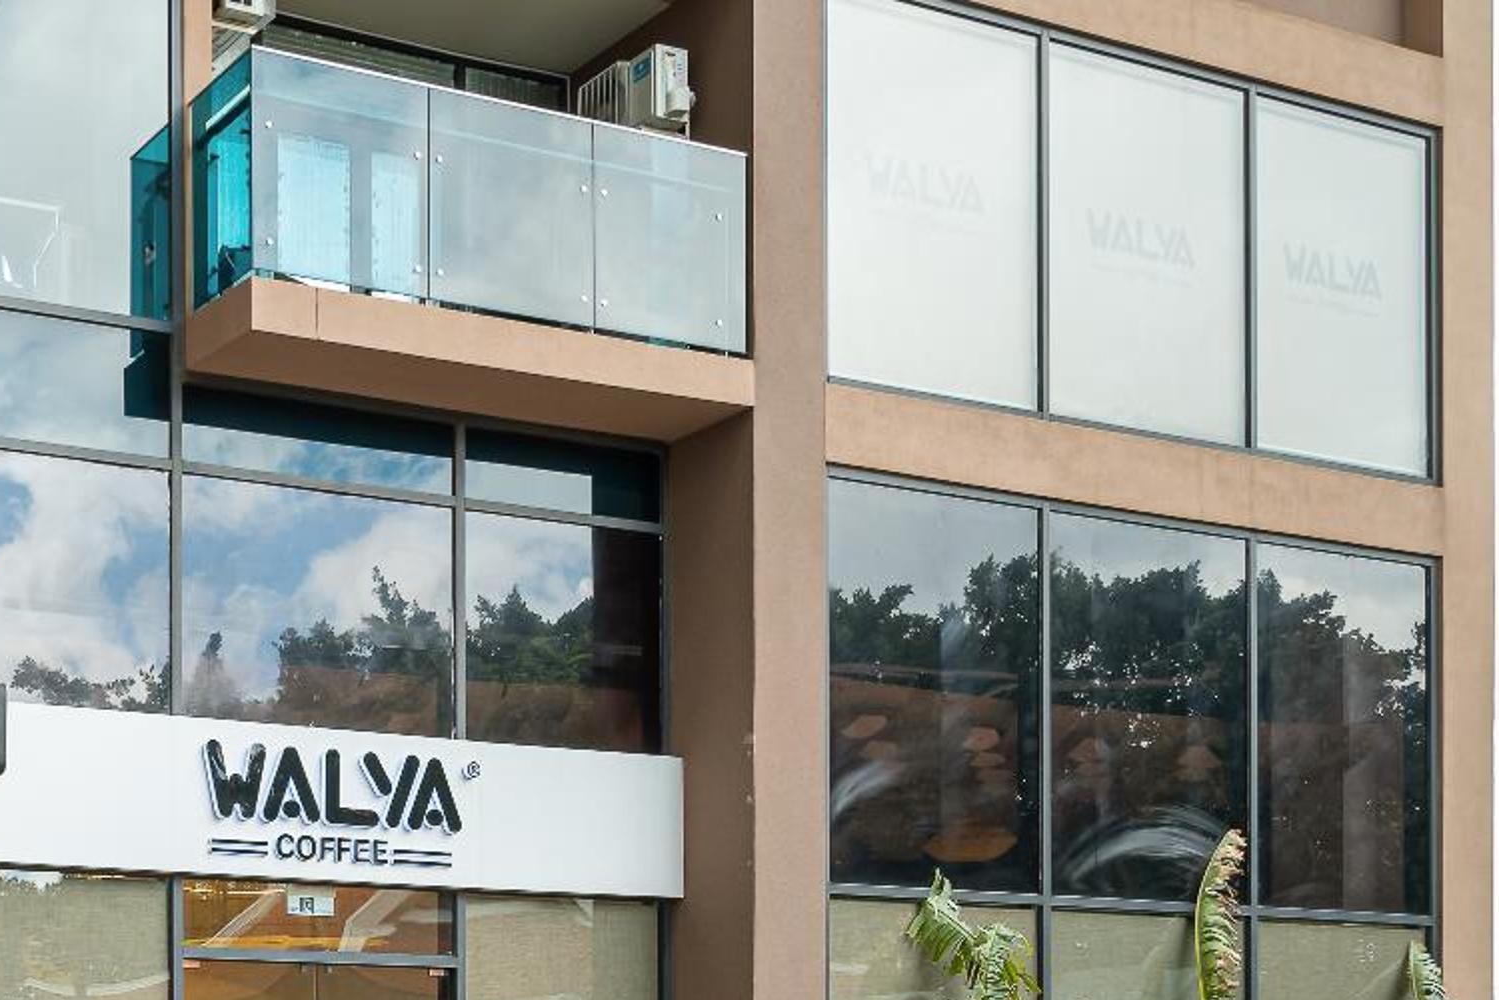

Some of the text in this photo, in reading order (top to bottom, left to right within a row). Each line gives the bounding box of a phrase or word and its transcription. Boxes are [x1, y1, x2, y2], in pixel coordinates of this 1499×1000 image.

[867, 155, 984, 213] WALYA
[1086, 207, 1196, 269] WALYA
[1283, 241, 1382, 300] WALYA
[205, 739, 463, 834] WALYA
[275, 833, 389, 864] COFFEE
